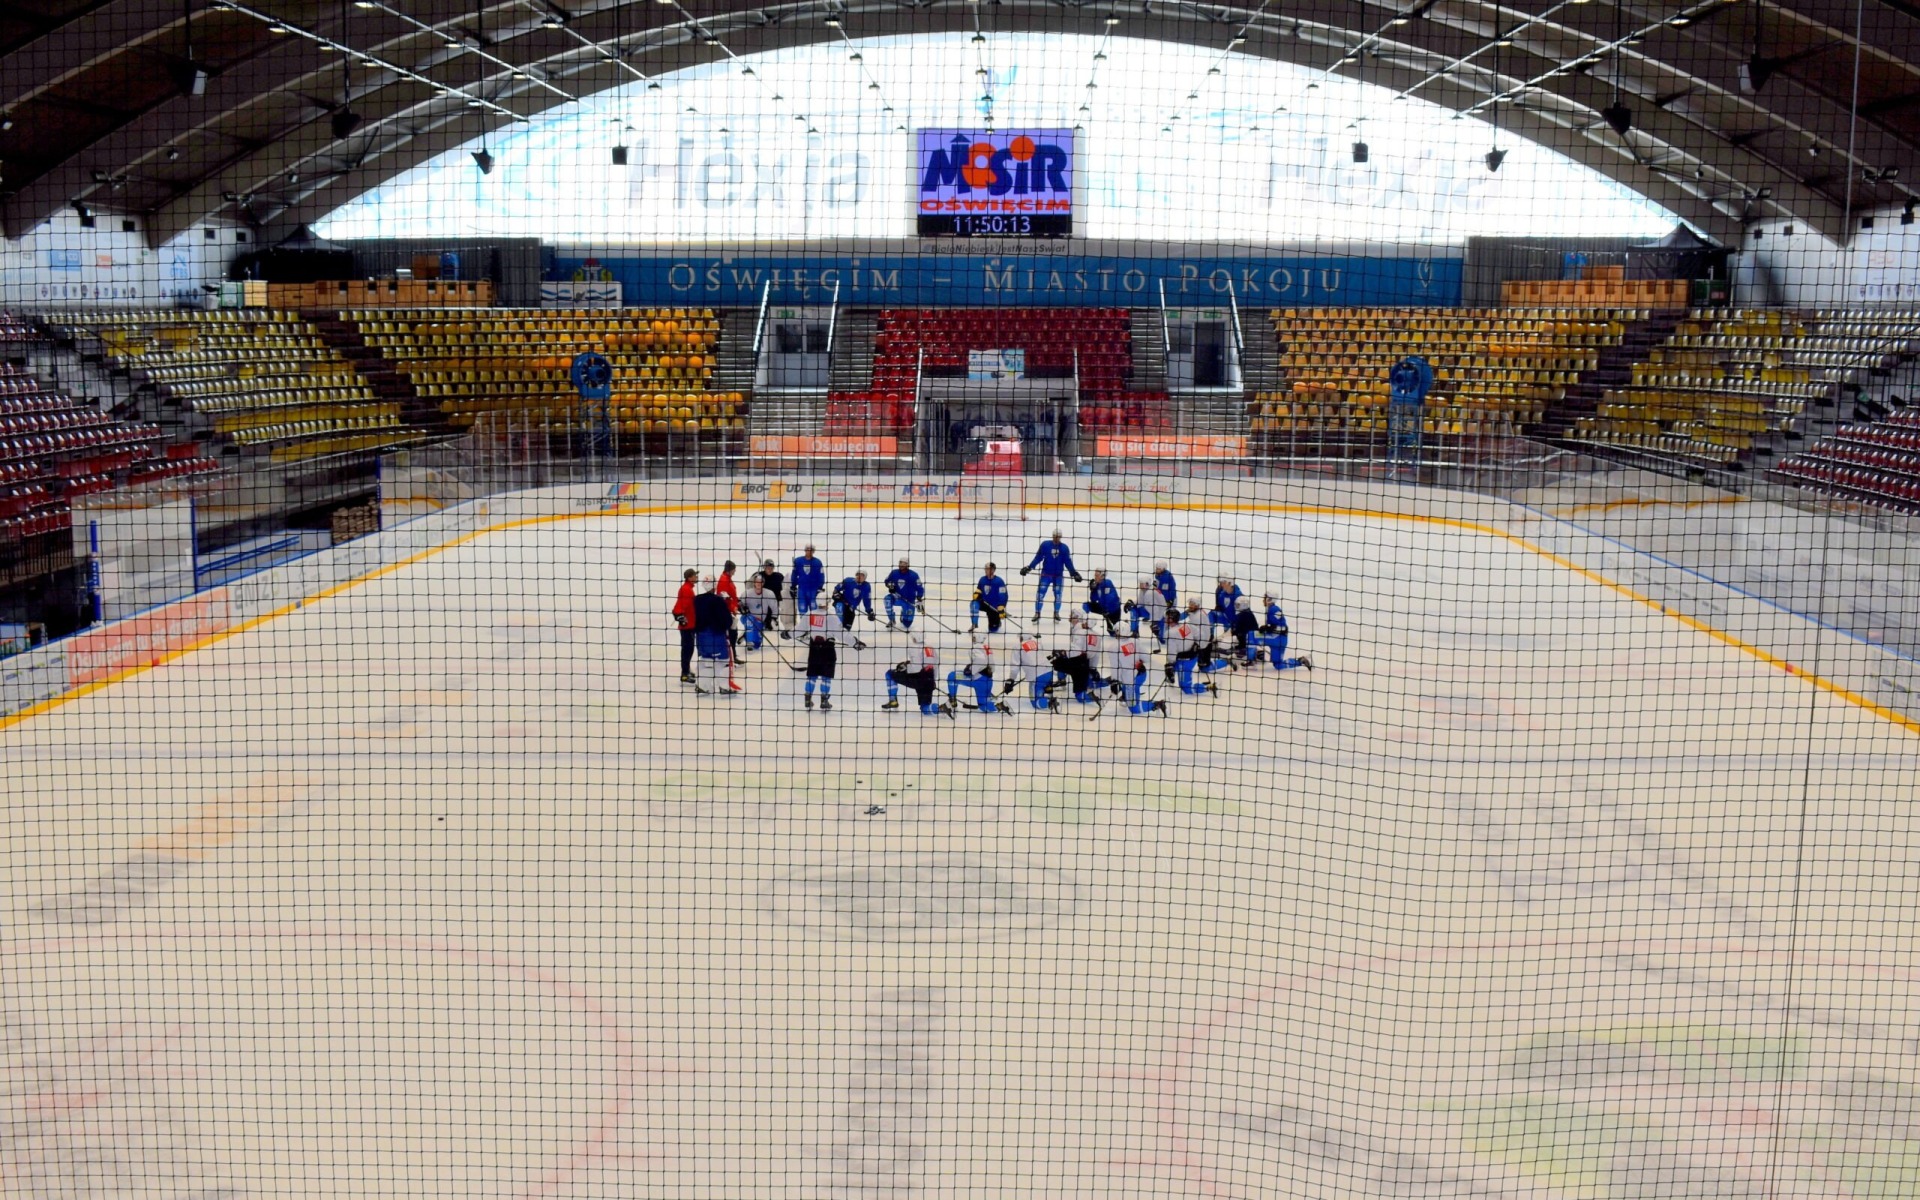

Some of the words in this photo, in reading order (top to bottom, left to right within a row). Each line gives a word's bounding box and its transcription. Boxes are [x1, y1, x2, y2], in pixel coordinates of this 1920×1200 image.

[920, 196, 1071, 213] OŚWIĘCIM
[953, 215, 1031, 232] 11:50:13
[982, 263, 1146, 293] MIASTO
[1179, 264, 1342, 297] POKOJU
